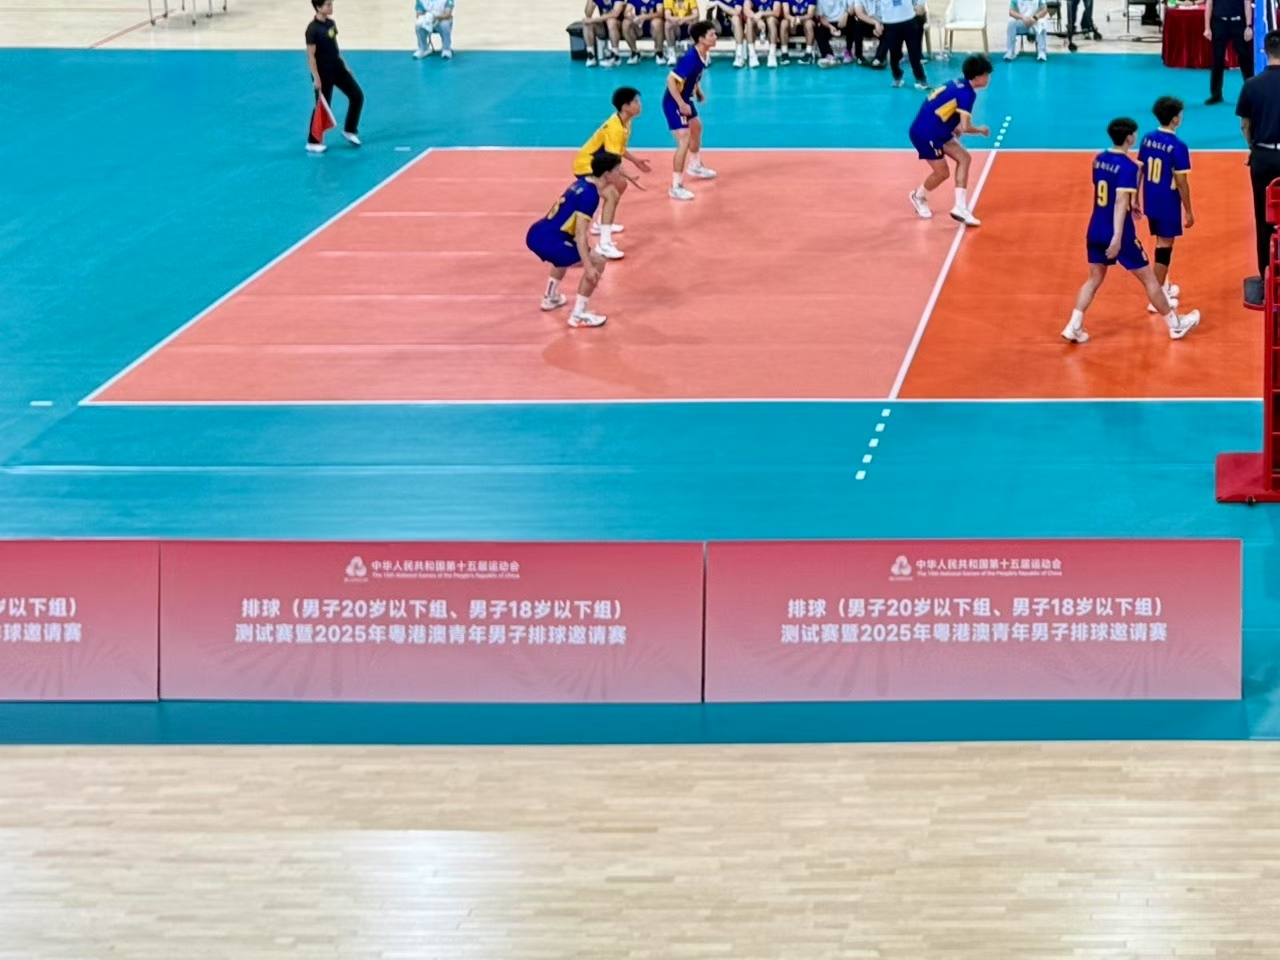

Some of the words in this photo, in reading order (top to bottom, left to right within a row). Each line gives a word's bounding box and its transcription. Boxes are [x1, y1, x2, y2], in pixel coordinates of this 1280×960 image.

[1147, 155, 1162, 185] 10
[1097, 179, 1109, 208] 9
[371, 560, 521, 572] 中华人民共和国第十五届运动会
[915, 558, 1063, 570] 中华人民共和国第十五届运动会
[242, 598, 622, 619] 排球（男子20岁以下组、男子18岁以下组）
[787, 596, 1164, 619] 排球（男子20岁以下组、男子18岁以下组）
